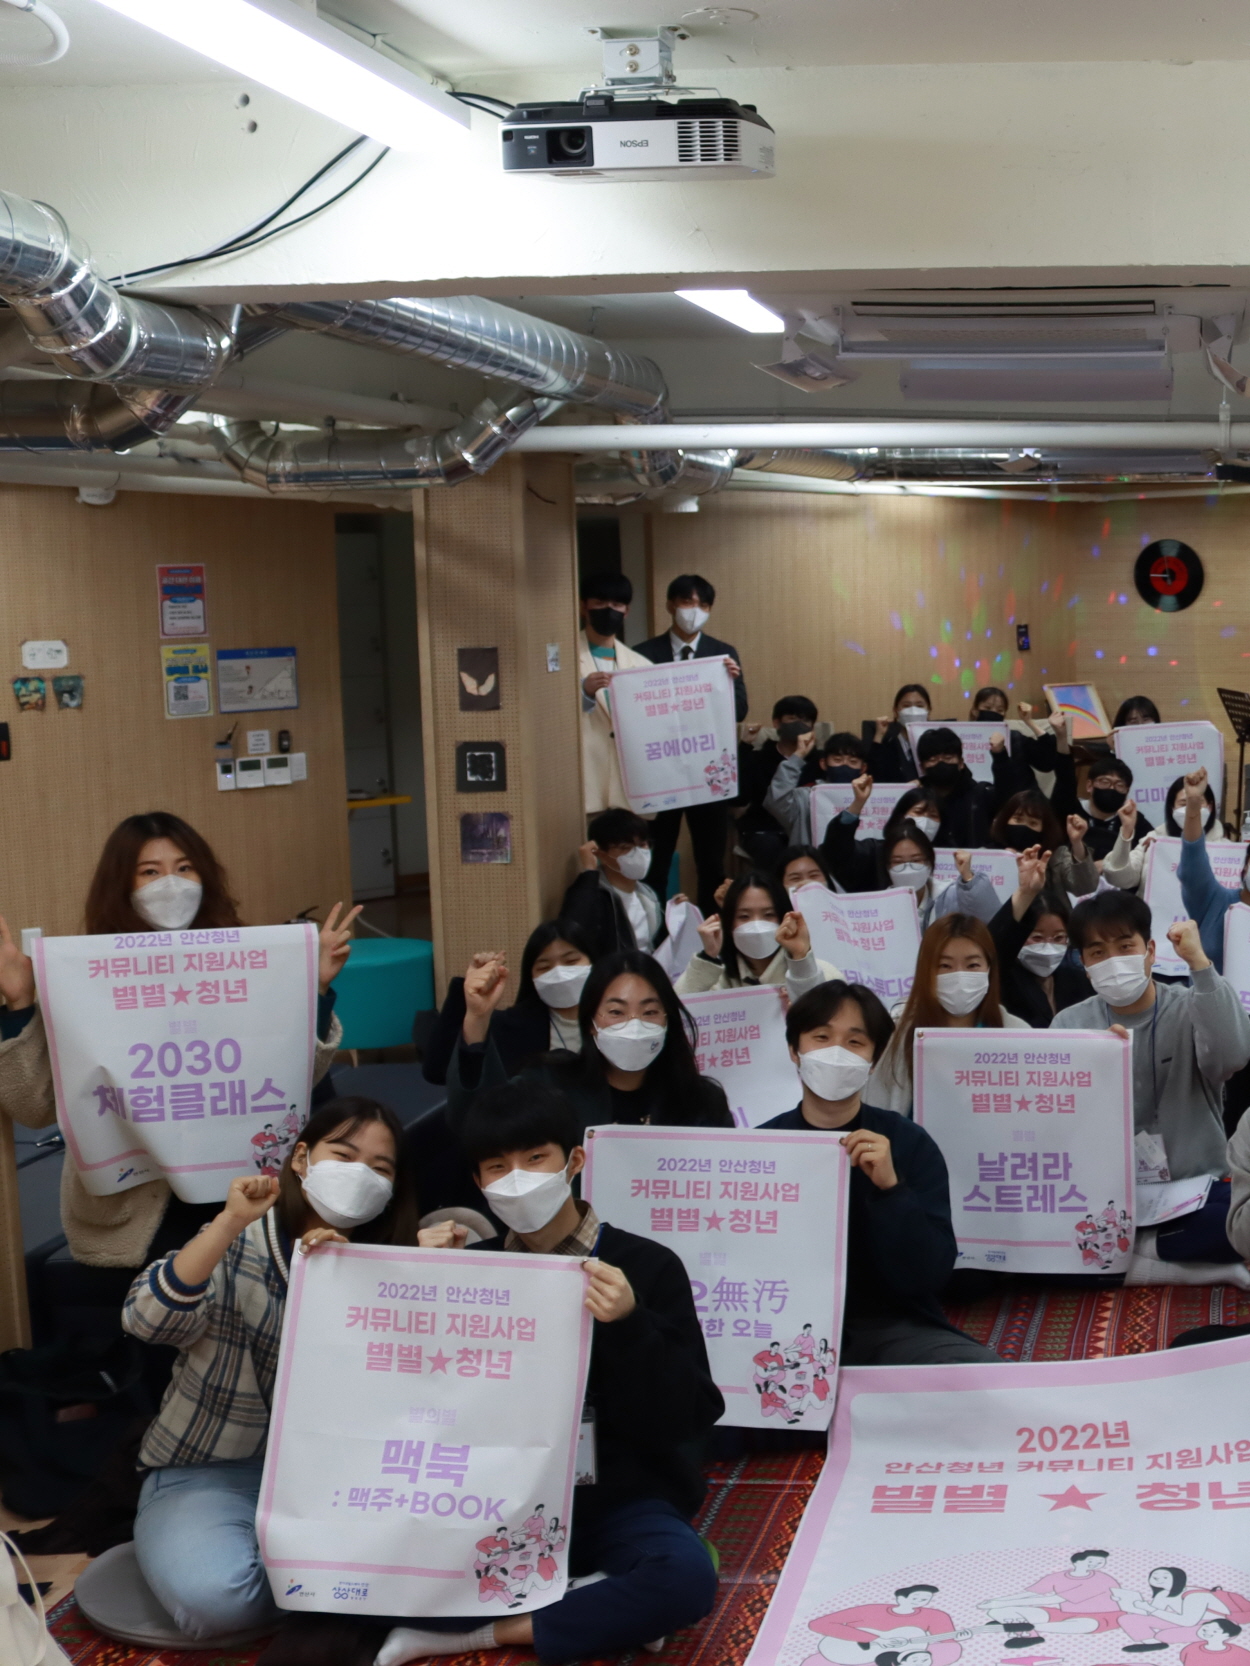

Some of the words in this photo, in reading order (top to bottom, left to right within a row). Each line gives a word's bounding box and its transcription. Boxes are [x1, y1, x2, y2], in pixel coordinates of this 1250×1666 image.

[619, 139, 649, 148] EPSON
[645, 734, 715, 760] 꿈에아리
[114, 930, 174, 950] 2022년
[180, 927, 241, 946] 안산청년
[88, 954, 174, 979] 커뮤니티
[183, 948, 269, 973] 지원사업
[713, 1010, 746, 1025] 안산청년
[714, 1024, 761, 1045] 지원사업
[127, 1037, 242, 1080] 2030
[973, 1051, 1019, 1065] 2022년
[1024, 1051, 1071, 1065] 안산청년
[953, 1069, 1020, 1088] 커뮤니티
[1025, 1069, 1093, 1089] 지원사업
[93, 1078, 287, 1124] 체험클래스
[656, 1156, 713, 1175] 2022년
[718, 1157, 776, 1176] 안산청년
[976, 1152, 1073, 1182] 날려라
[630, 1179, 712, 1202] 커뮤니티
[718, 1179, 801, 1205] 지원사업
[961, 1185, 1089, 1215] 스트레스
[377, 1281, 438, 1301] 2022년
[446, 1285, 511, 1306] 안산청년
[345, 1305, 436, 1336] 커뮤니티
[445, 1311, 537, 1342] 지원사업
[732, 1318, 773, 1339] 오늘
[1016, 1420, 1131, 1453] 2022년
[381, 1439, 471, 1488] 맥북
[884, 1461, 1005, 1476] 안산청년
[1017, 1457, 1135, 1473] 커뮤니티
[347, 1487, 507, 1523] 맥주+BOOK
[870, 1483, 1009, 1514] 별별
